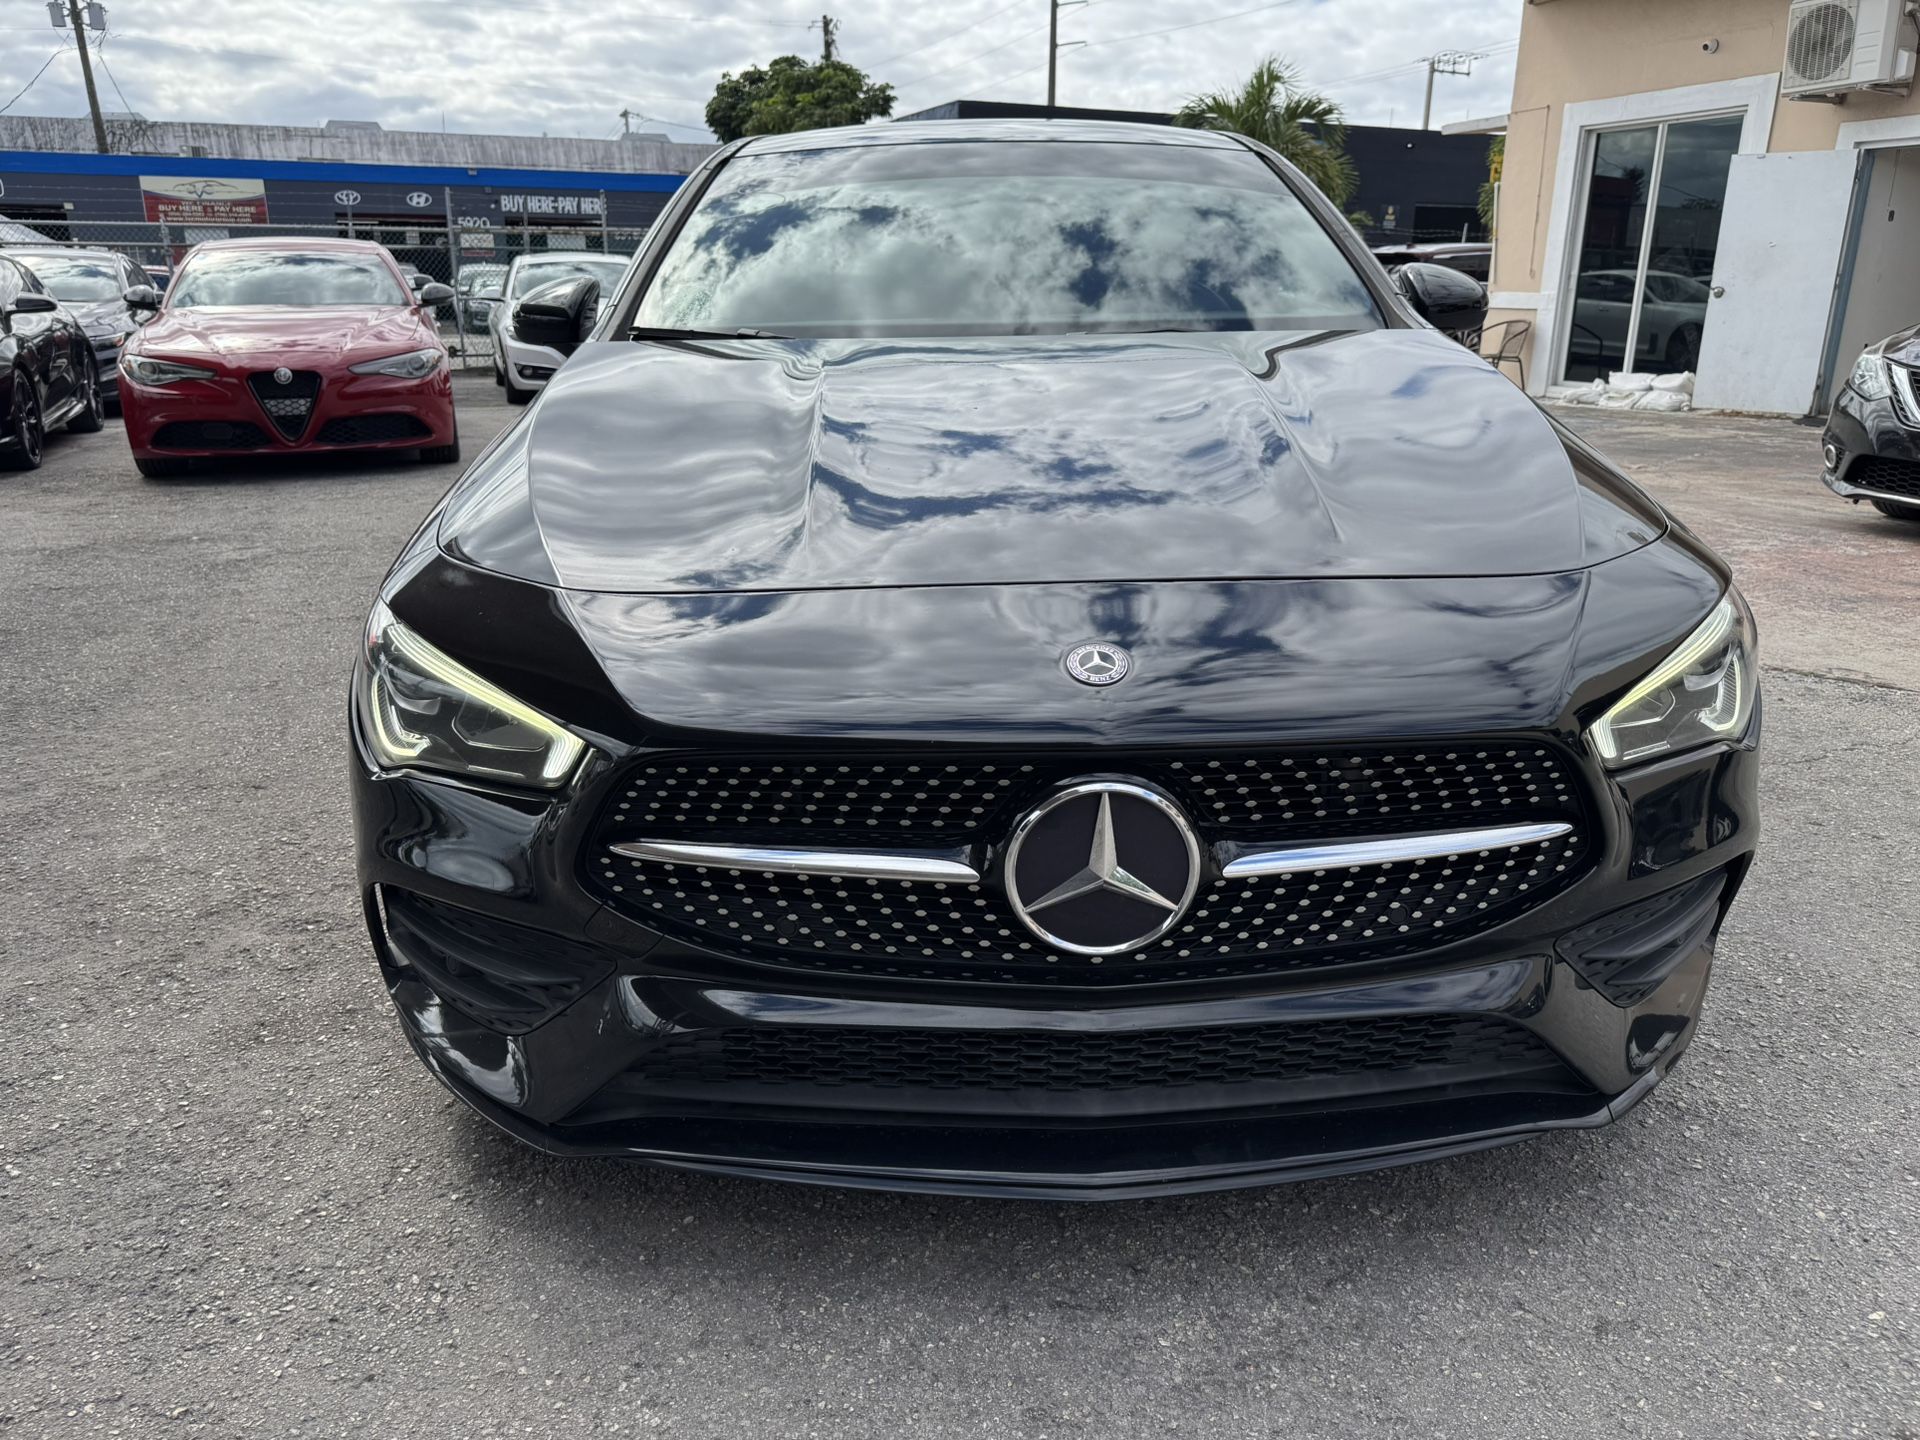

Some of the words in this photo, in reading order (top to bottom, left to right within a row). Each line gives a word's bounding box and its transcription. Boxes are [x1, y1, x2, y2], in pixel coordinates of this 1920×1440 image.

[158, 203, 178, 212] BUY
[178, 204, 204, 213] HERE
[214, 205, 231, 213] PAY
[232, 206, 257, 214] HERE
[500, 194, 524, 213] BUY
